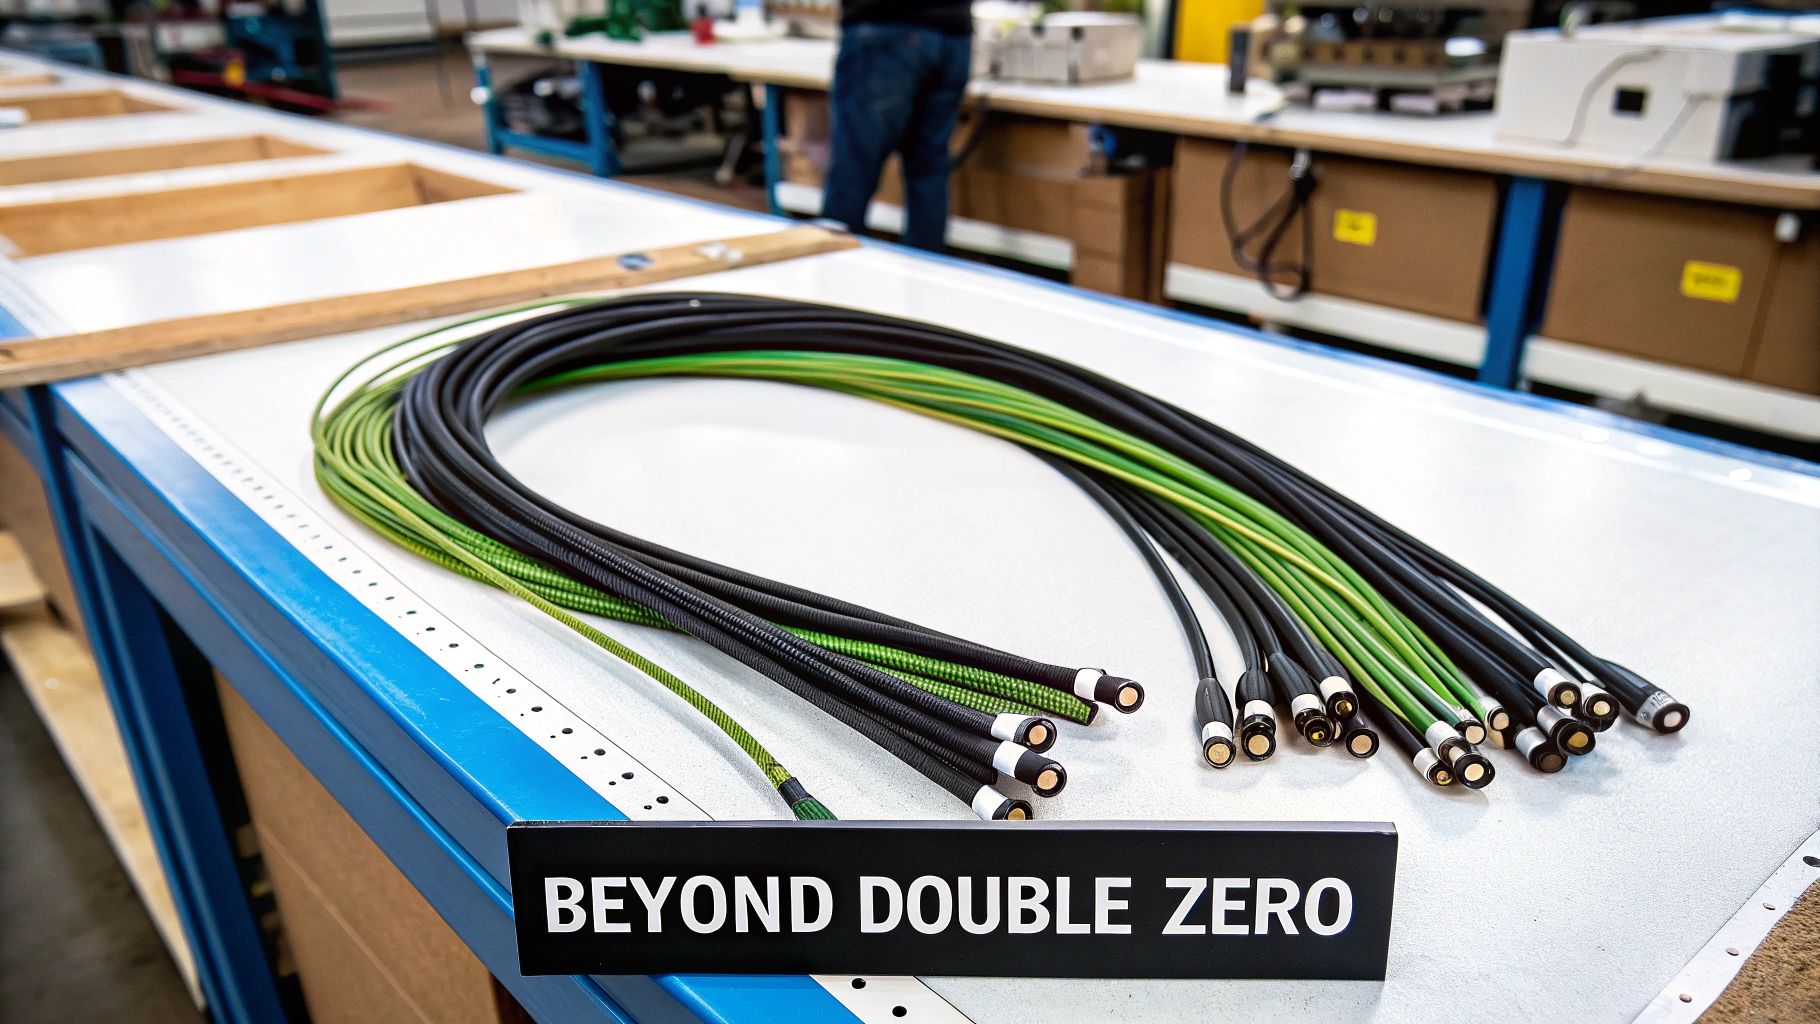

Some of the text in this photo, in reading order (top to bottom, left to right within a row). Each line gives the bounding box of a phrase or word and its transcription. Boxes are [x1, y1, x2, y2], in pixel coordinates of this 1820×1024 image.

[544, 875, 1353, 936] BEYOND DOUBLE ZERO
